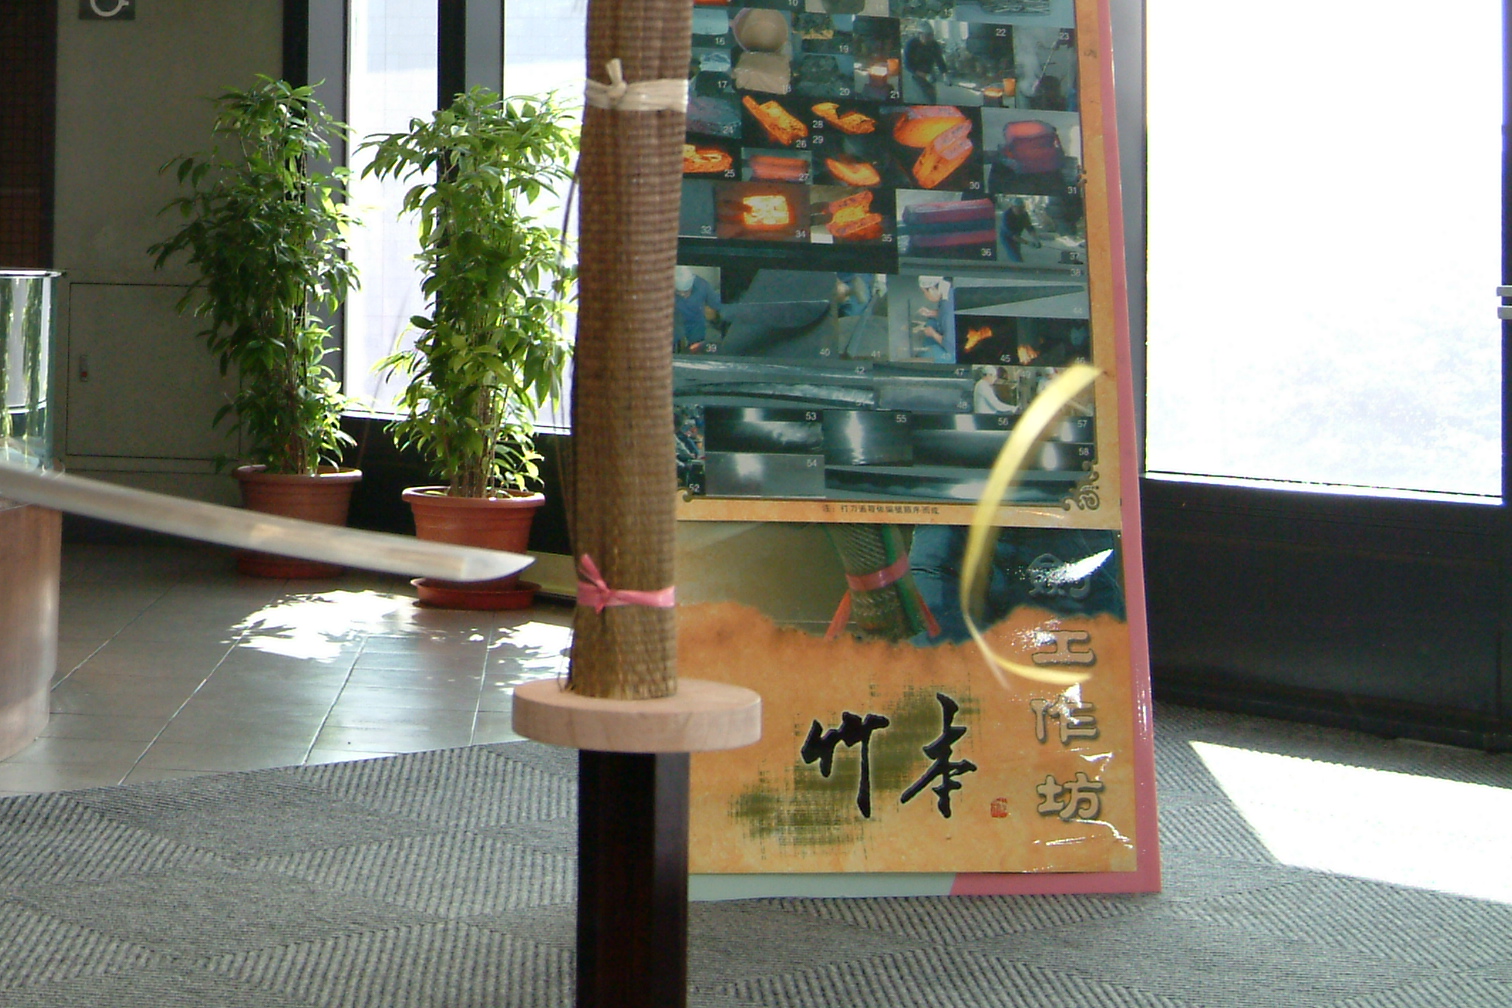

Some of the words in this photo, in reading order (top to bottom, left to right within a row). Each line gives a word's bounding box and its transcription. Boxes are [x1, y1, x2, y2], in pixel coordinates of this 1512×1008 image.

[995, 28, 1006, 37] 22
[1059, 32, 1070, 40] 23
[839, 88, 850, 96] 20
[890, 91, 900, 99] 21
[812, 120, 823, 129] 28
[812, 135, 824, 144] 29
[724, 169, 735, 178] 25
[798, 173, 810, 181] 27
[969, 182, 980, 190] 30
[1067, 186, 1077, 194] 31
[700, 226, 712, 234] 32
[795, 230, 806, 238] 34
[1069, 253, 1079, 261] 37
[1070, 269, 1081, 277] 38
[705, 343, 717, 353] 39
[819, 348, 831, 357] 40
[1000, 354, 1011, 363] 45
[954, 368, 965, 377] 47
[805, 411, 817, 420] 53
[896, 414, 907, 423] 55
[998, 417, 1009, 426] 56
[1077, 420, 1088, 428] 57
[1078, 448, 1089, 456] 58
[689, 483, 700, 492] 52
